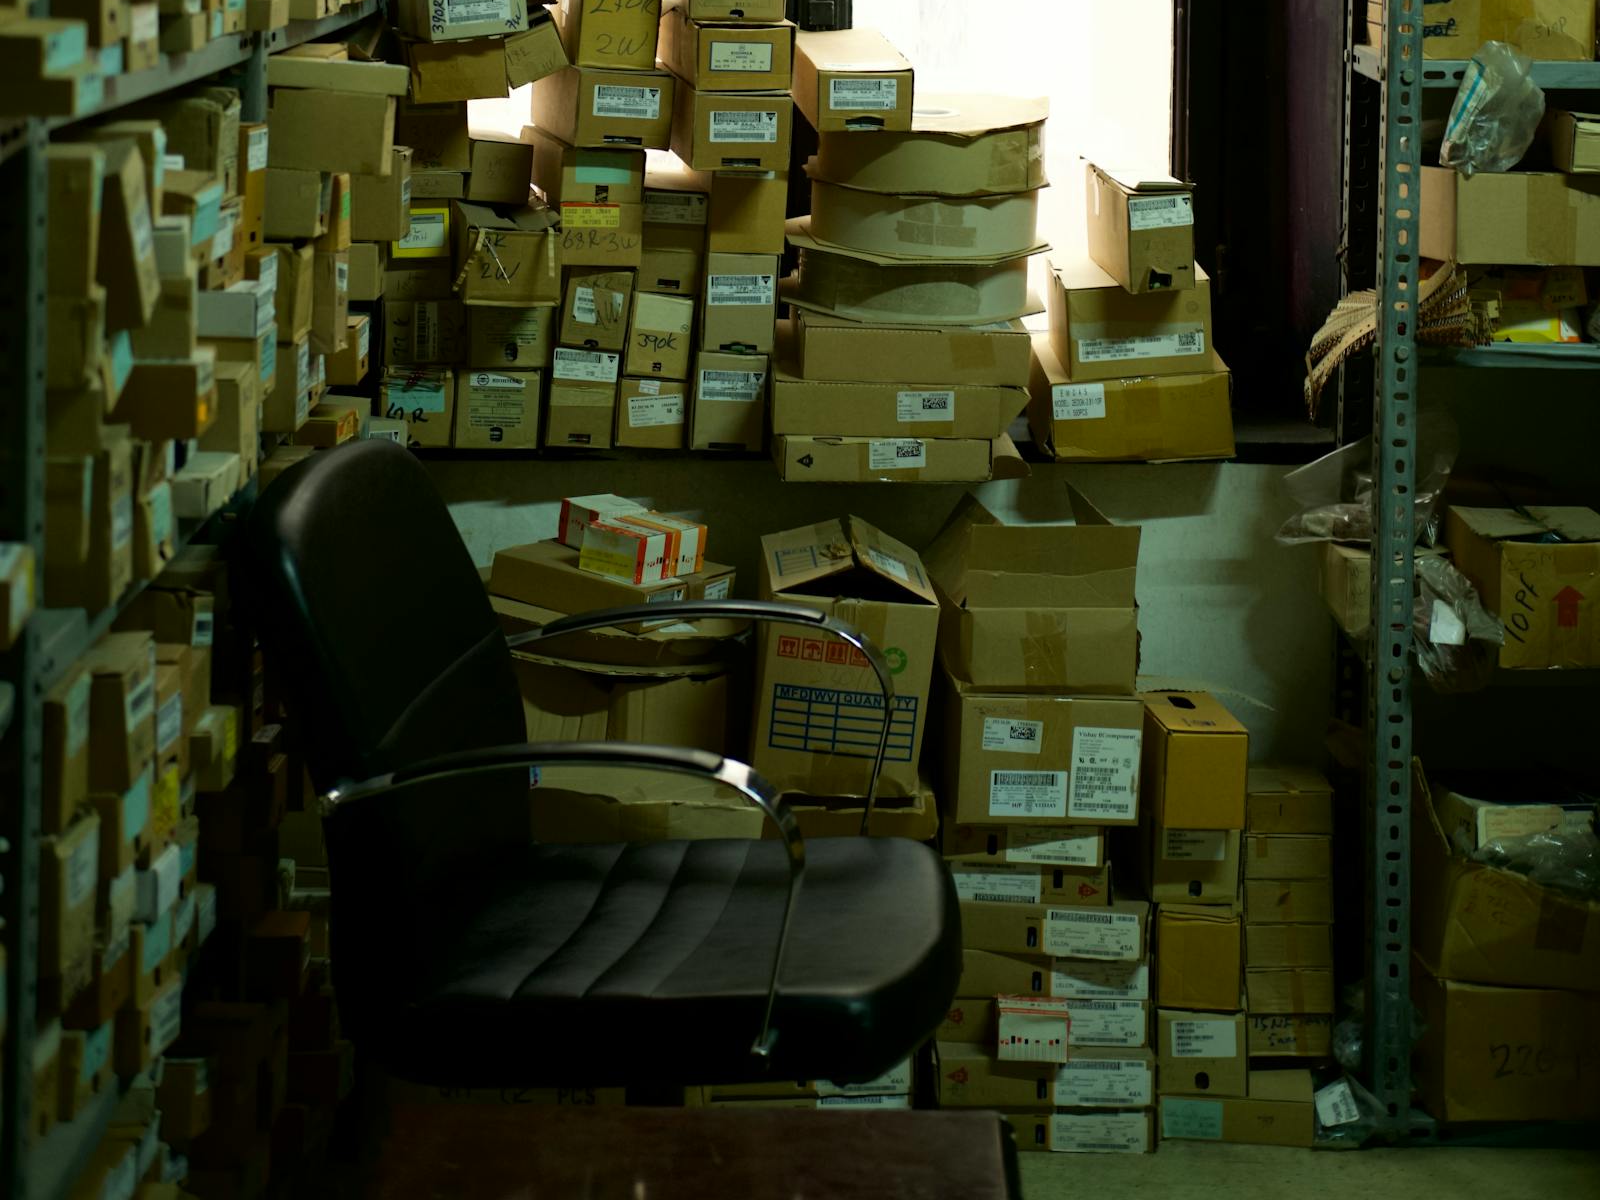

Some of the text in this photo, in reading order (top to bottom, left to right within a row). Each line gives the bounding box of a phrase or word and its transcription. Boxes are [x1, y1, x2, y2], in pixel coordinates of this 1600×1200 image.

[432, 0, 446, 34] 390R
[780, 686, 809, 700] MFD
[814, 690, 835, 702] WV
